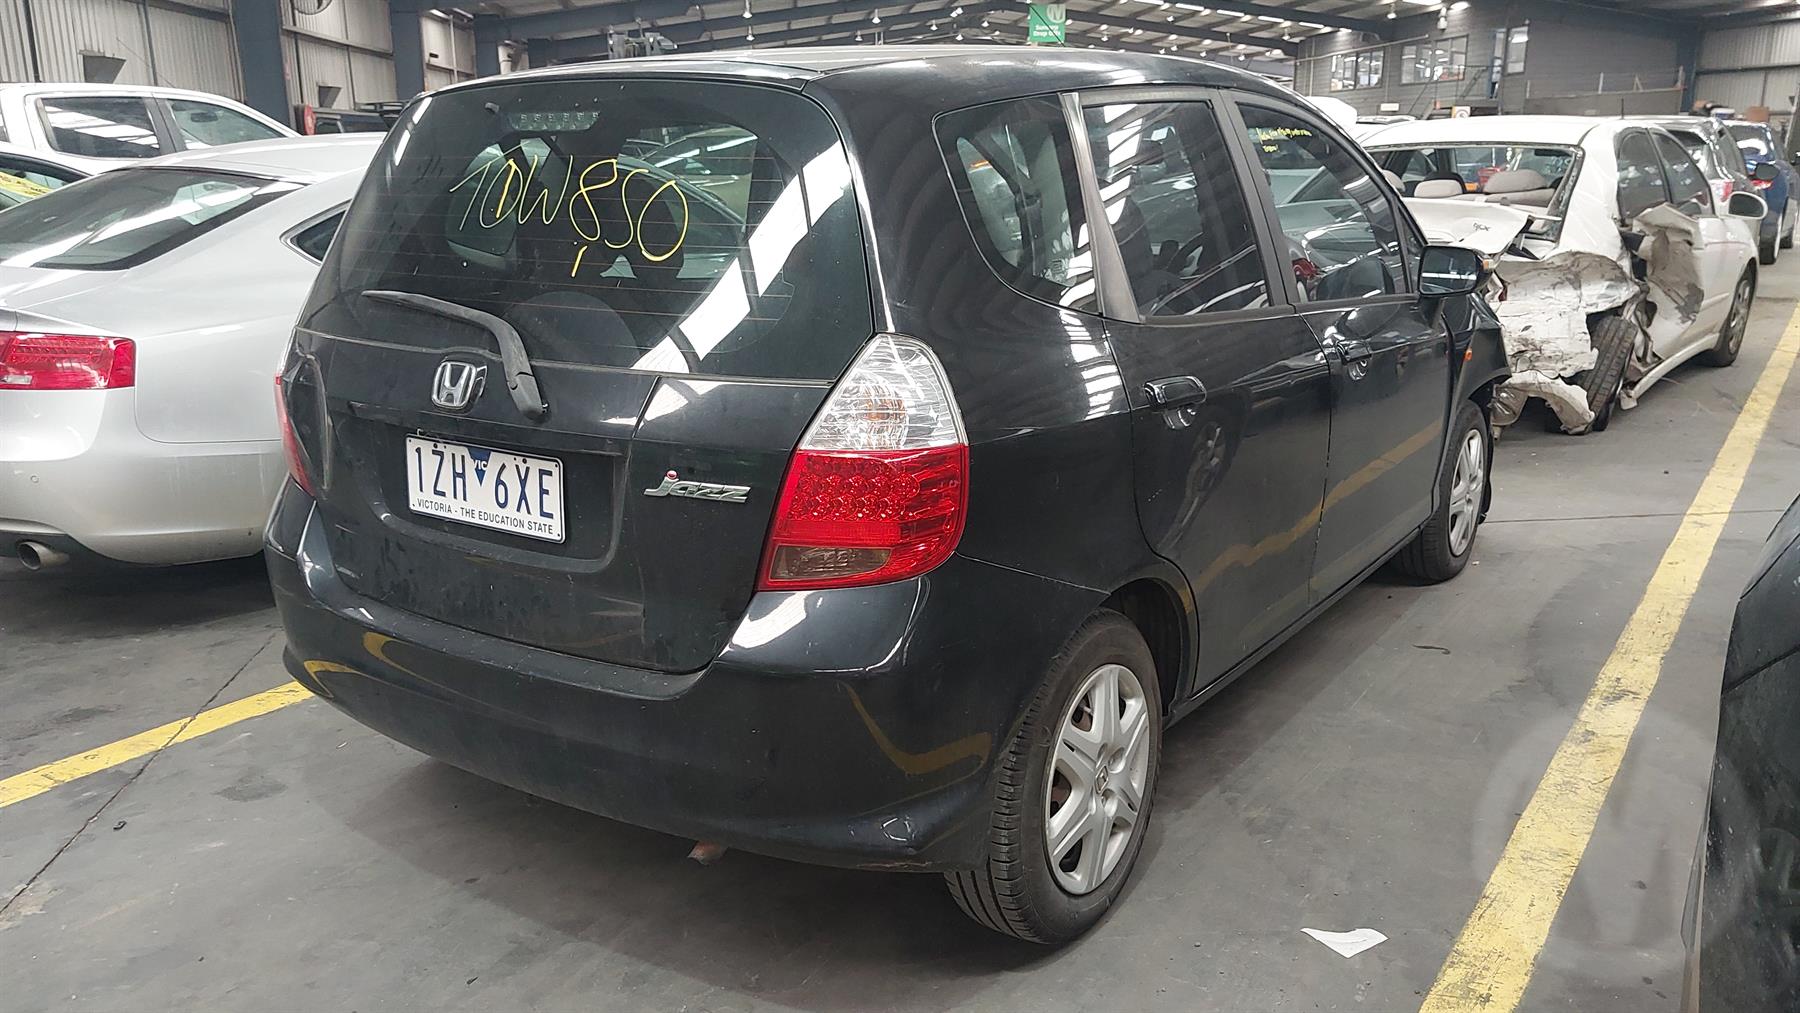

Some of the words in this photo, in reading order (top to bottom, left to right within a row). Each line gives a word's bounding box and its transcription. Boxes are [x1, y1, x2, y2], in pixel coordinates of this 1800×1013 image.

[416, 498, 453, 514] VICTORIA
[460, 507, 476, 519] THE
[478, 510, 525, 529] EDUCATION
[527, 520, 554, 535] STATE
